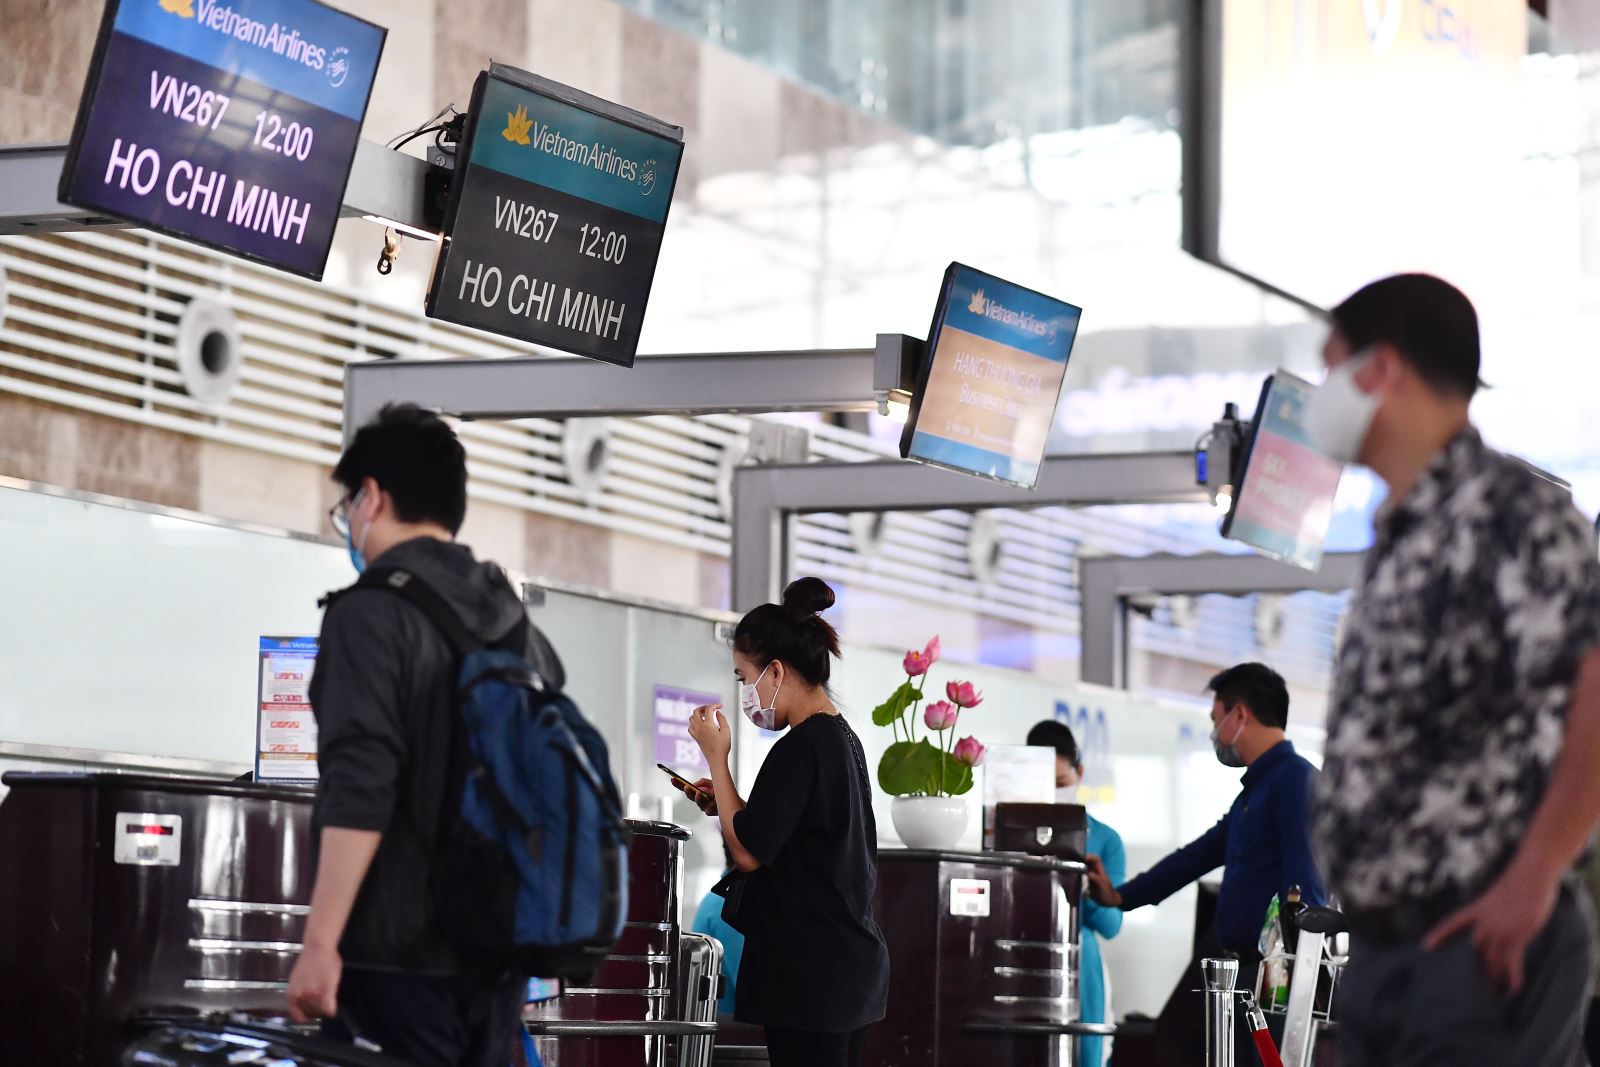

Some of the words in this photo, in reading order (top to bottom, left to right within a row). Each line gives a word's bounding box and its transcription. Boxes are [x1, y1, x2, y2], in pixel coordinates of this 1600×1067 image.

[150, 70, 231, 130] VN267
[253, 110, 314, 161] 12:00
[104, 138, 161, 196] HO
[165, 160, 227, 218] CHI
[226, 179, 312, 245] MINH
[494, 195, 559, 244] VN267
[578, 223, 627, 265] 12:00
[458, 259, 503, 308] HO
[508, 274, 556, 323] CHI
[557, 287, 626, 341] MINH
